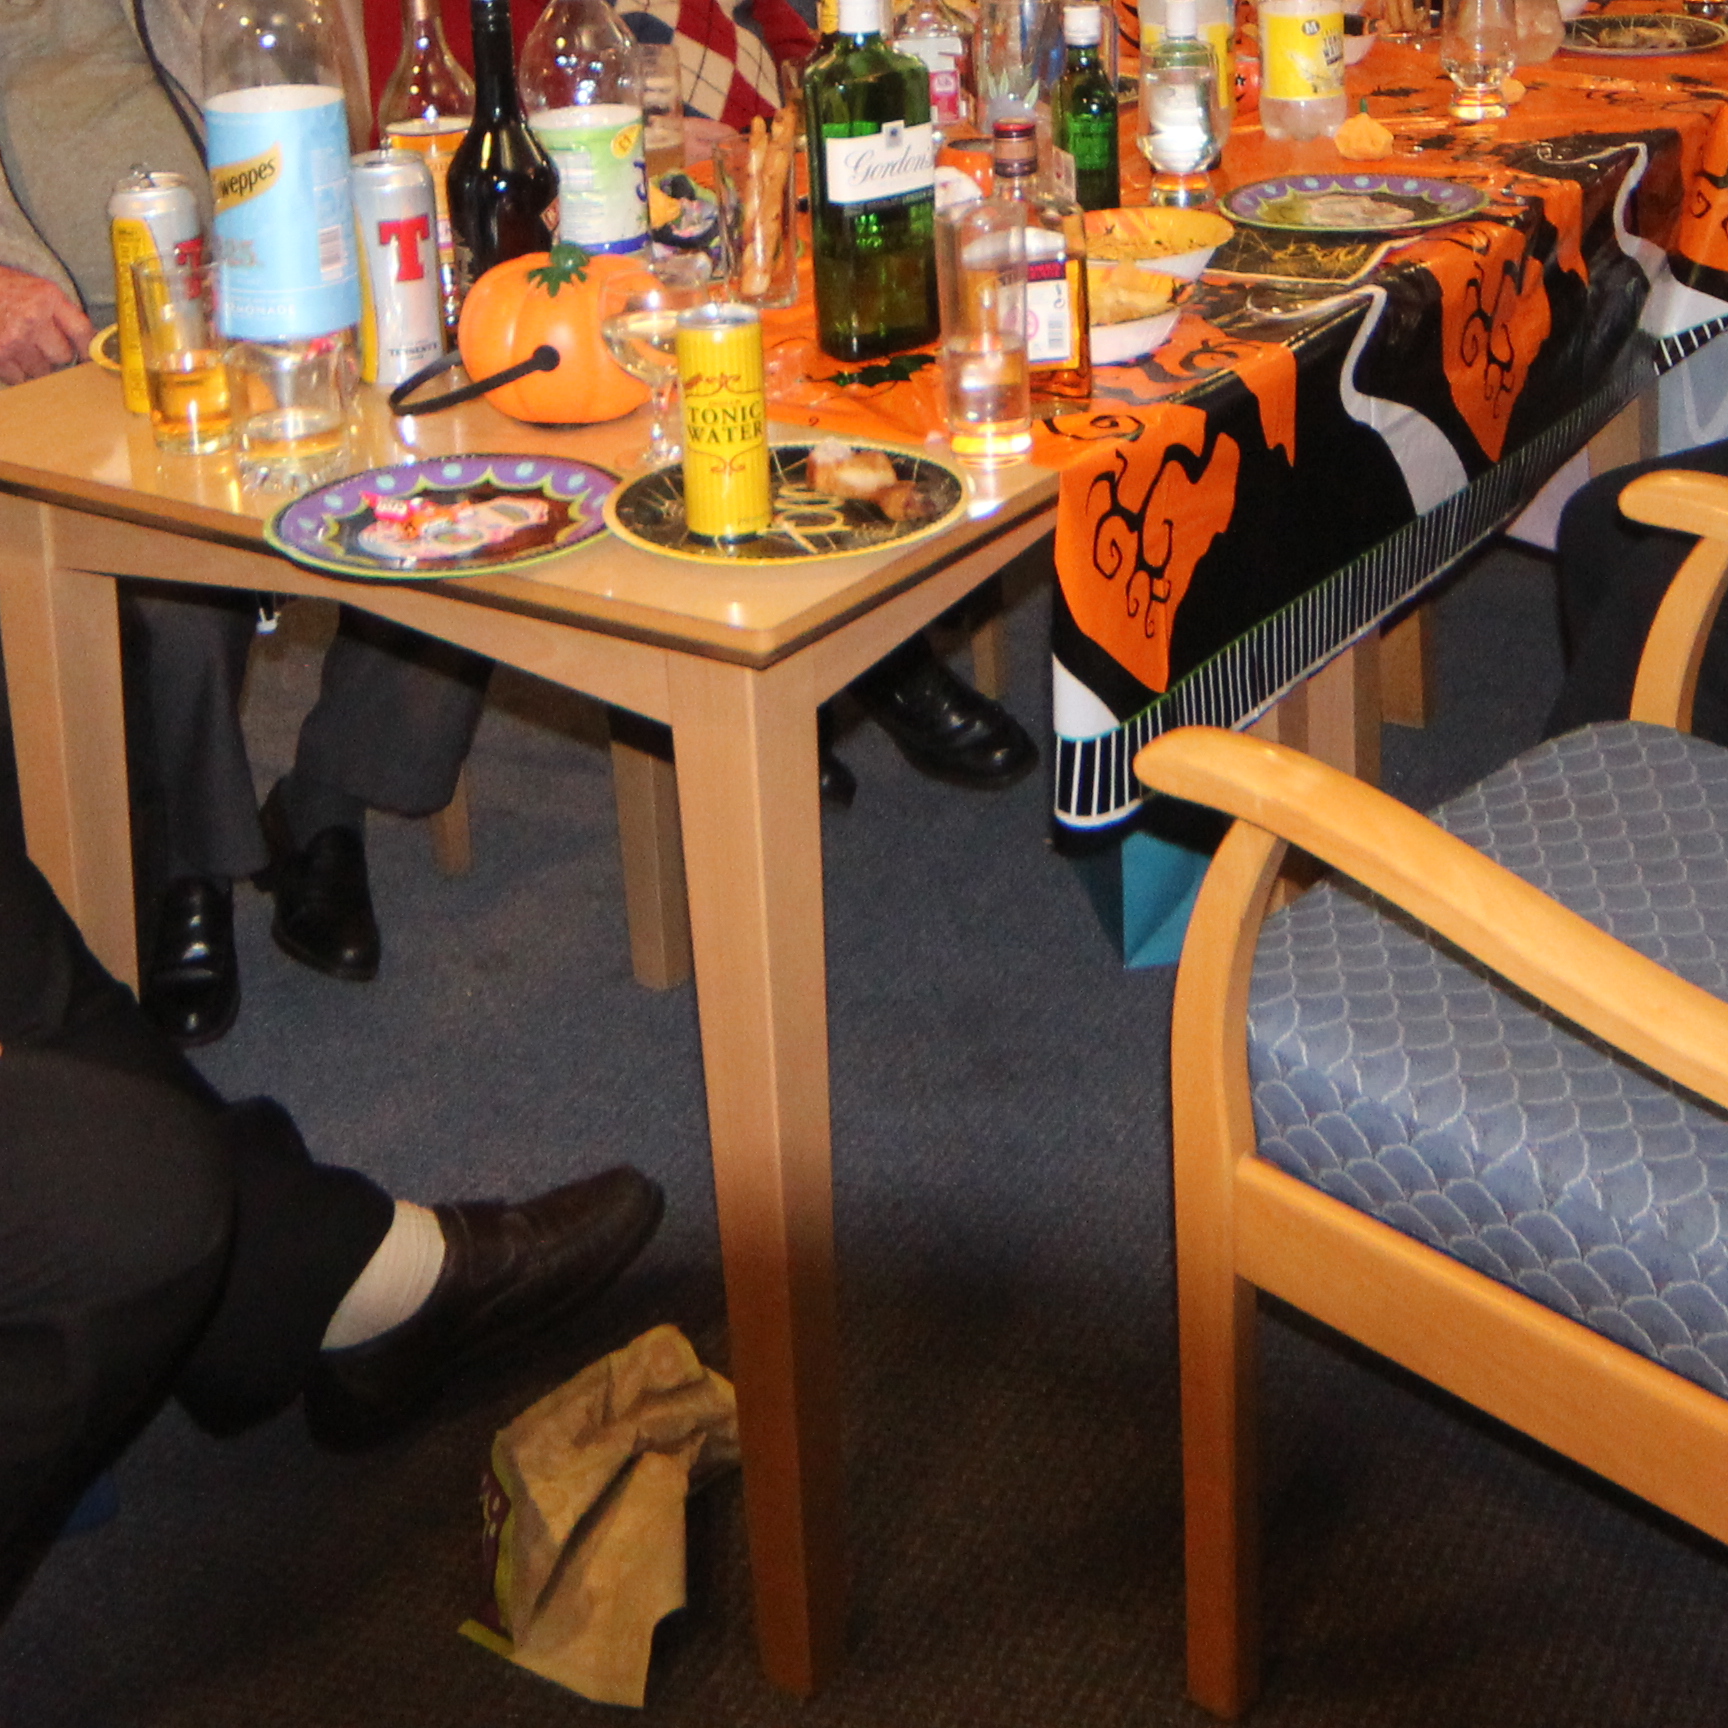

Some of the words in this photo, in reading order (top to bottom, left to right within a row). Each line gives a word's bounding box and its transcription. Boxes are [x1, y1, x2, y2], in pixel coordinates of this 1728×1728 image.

[219, 158, 277, 197] weppes
[378, 214, 430, 282] T
[687, 400, 762, 425] TONIC
[687, 420, 763, 444] WATER
